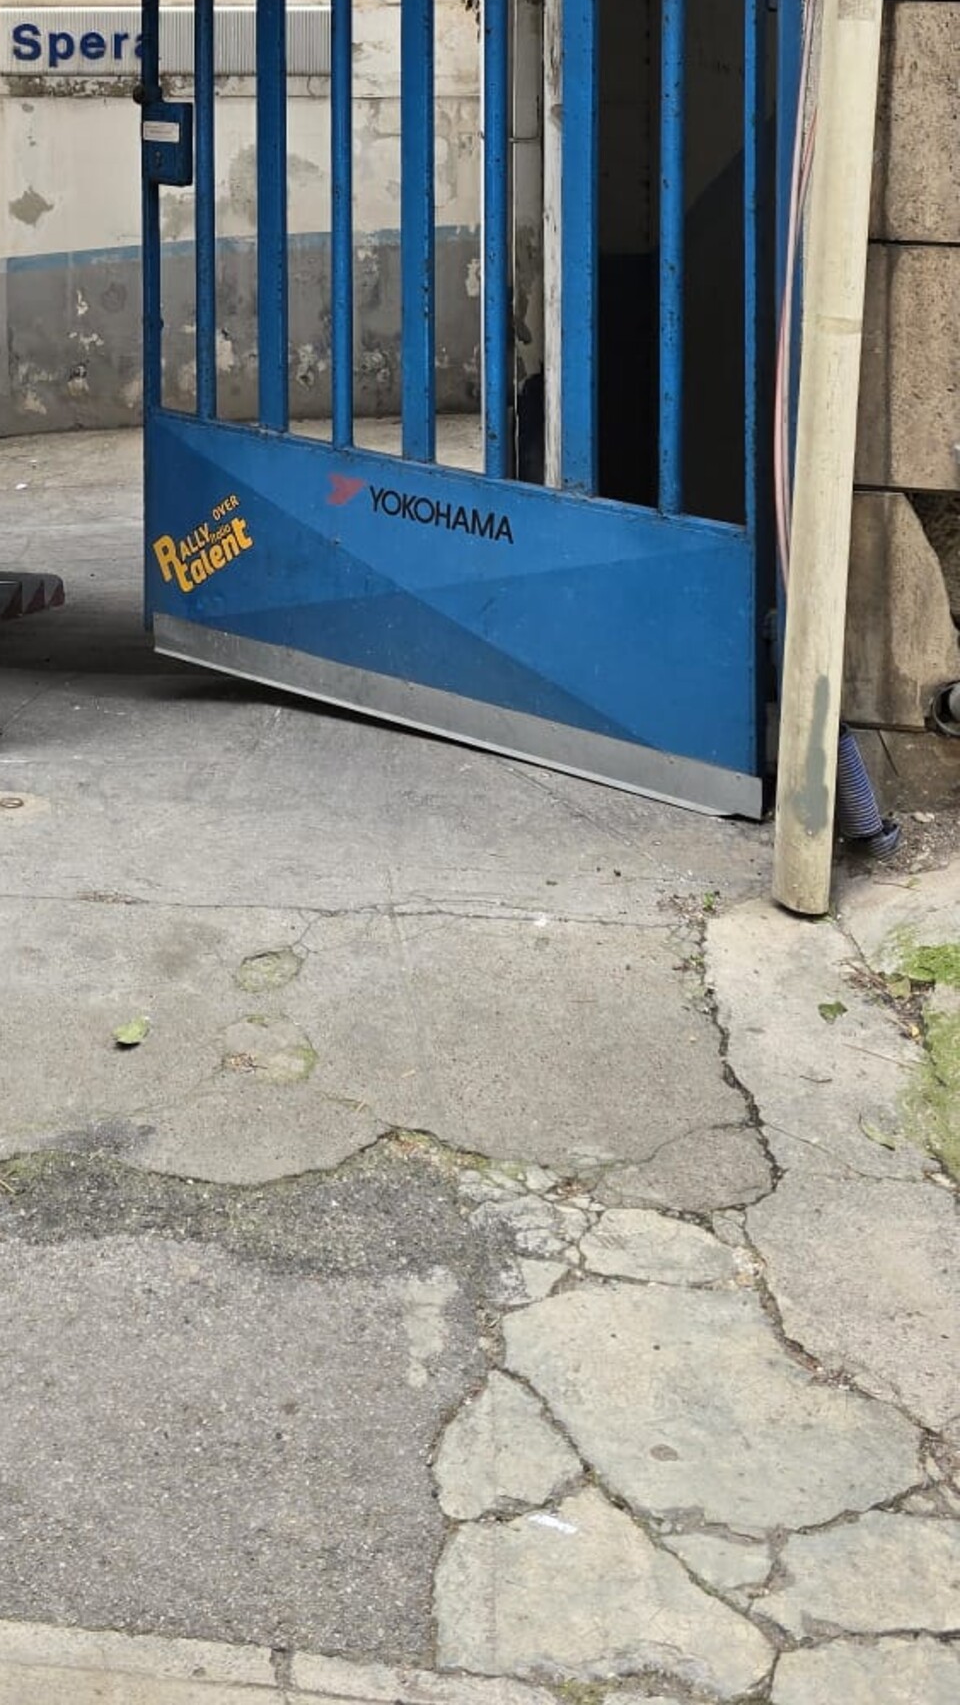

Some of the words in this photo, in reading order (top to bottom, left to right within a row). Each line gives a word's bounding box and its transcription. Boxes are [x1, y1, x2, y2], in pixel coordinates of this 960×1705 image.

[212, 495, 240, 521] OVER
[370, 485, 514, 544] YOKOHAMA
[153, 522, 210, 583] RALLY
[176, 517, 253, 592] talent
